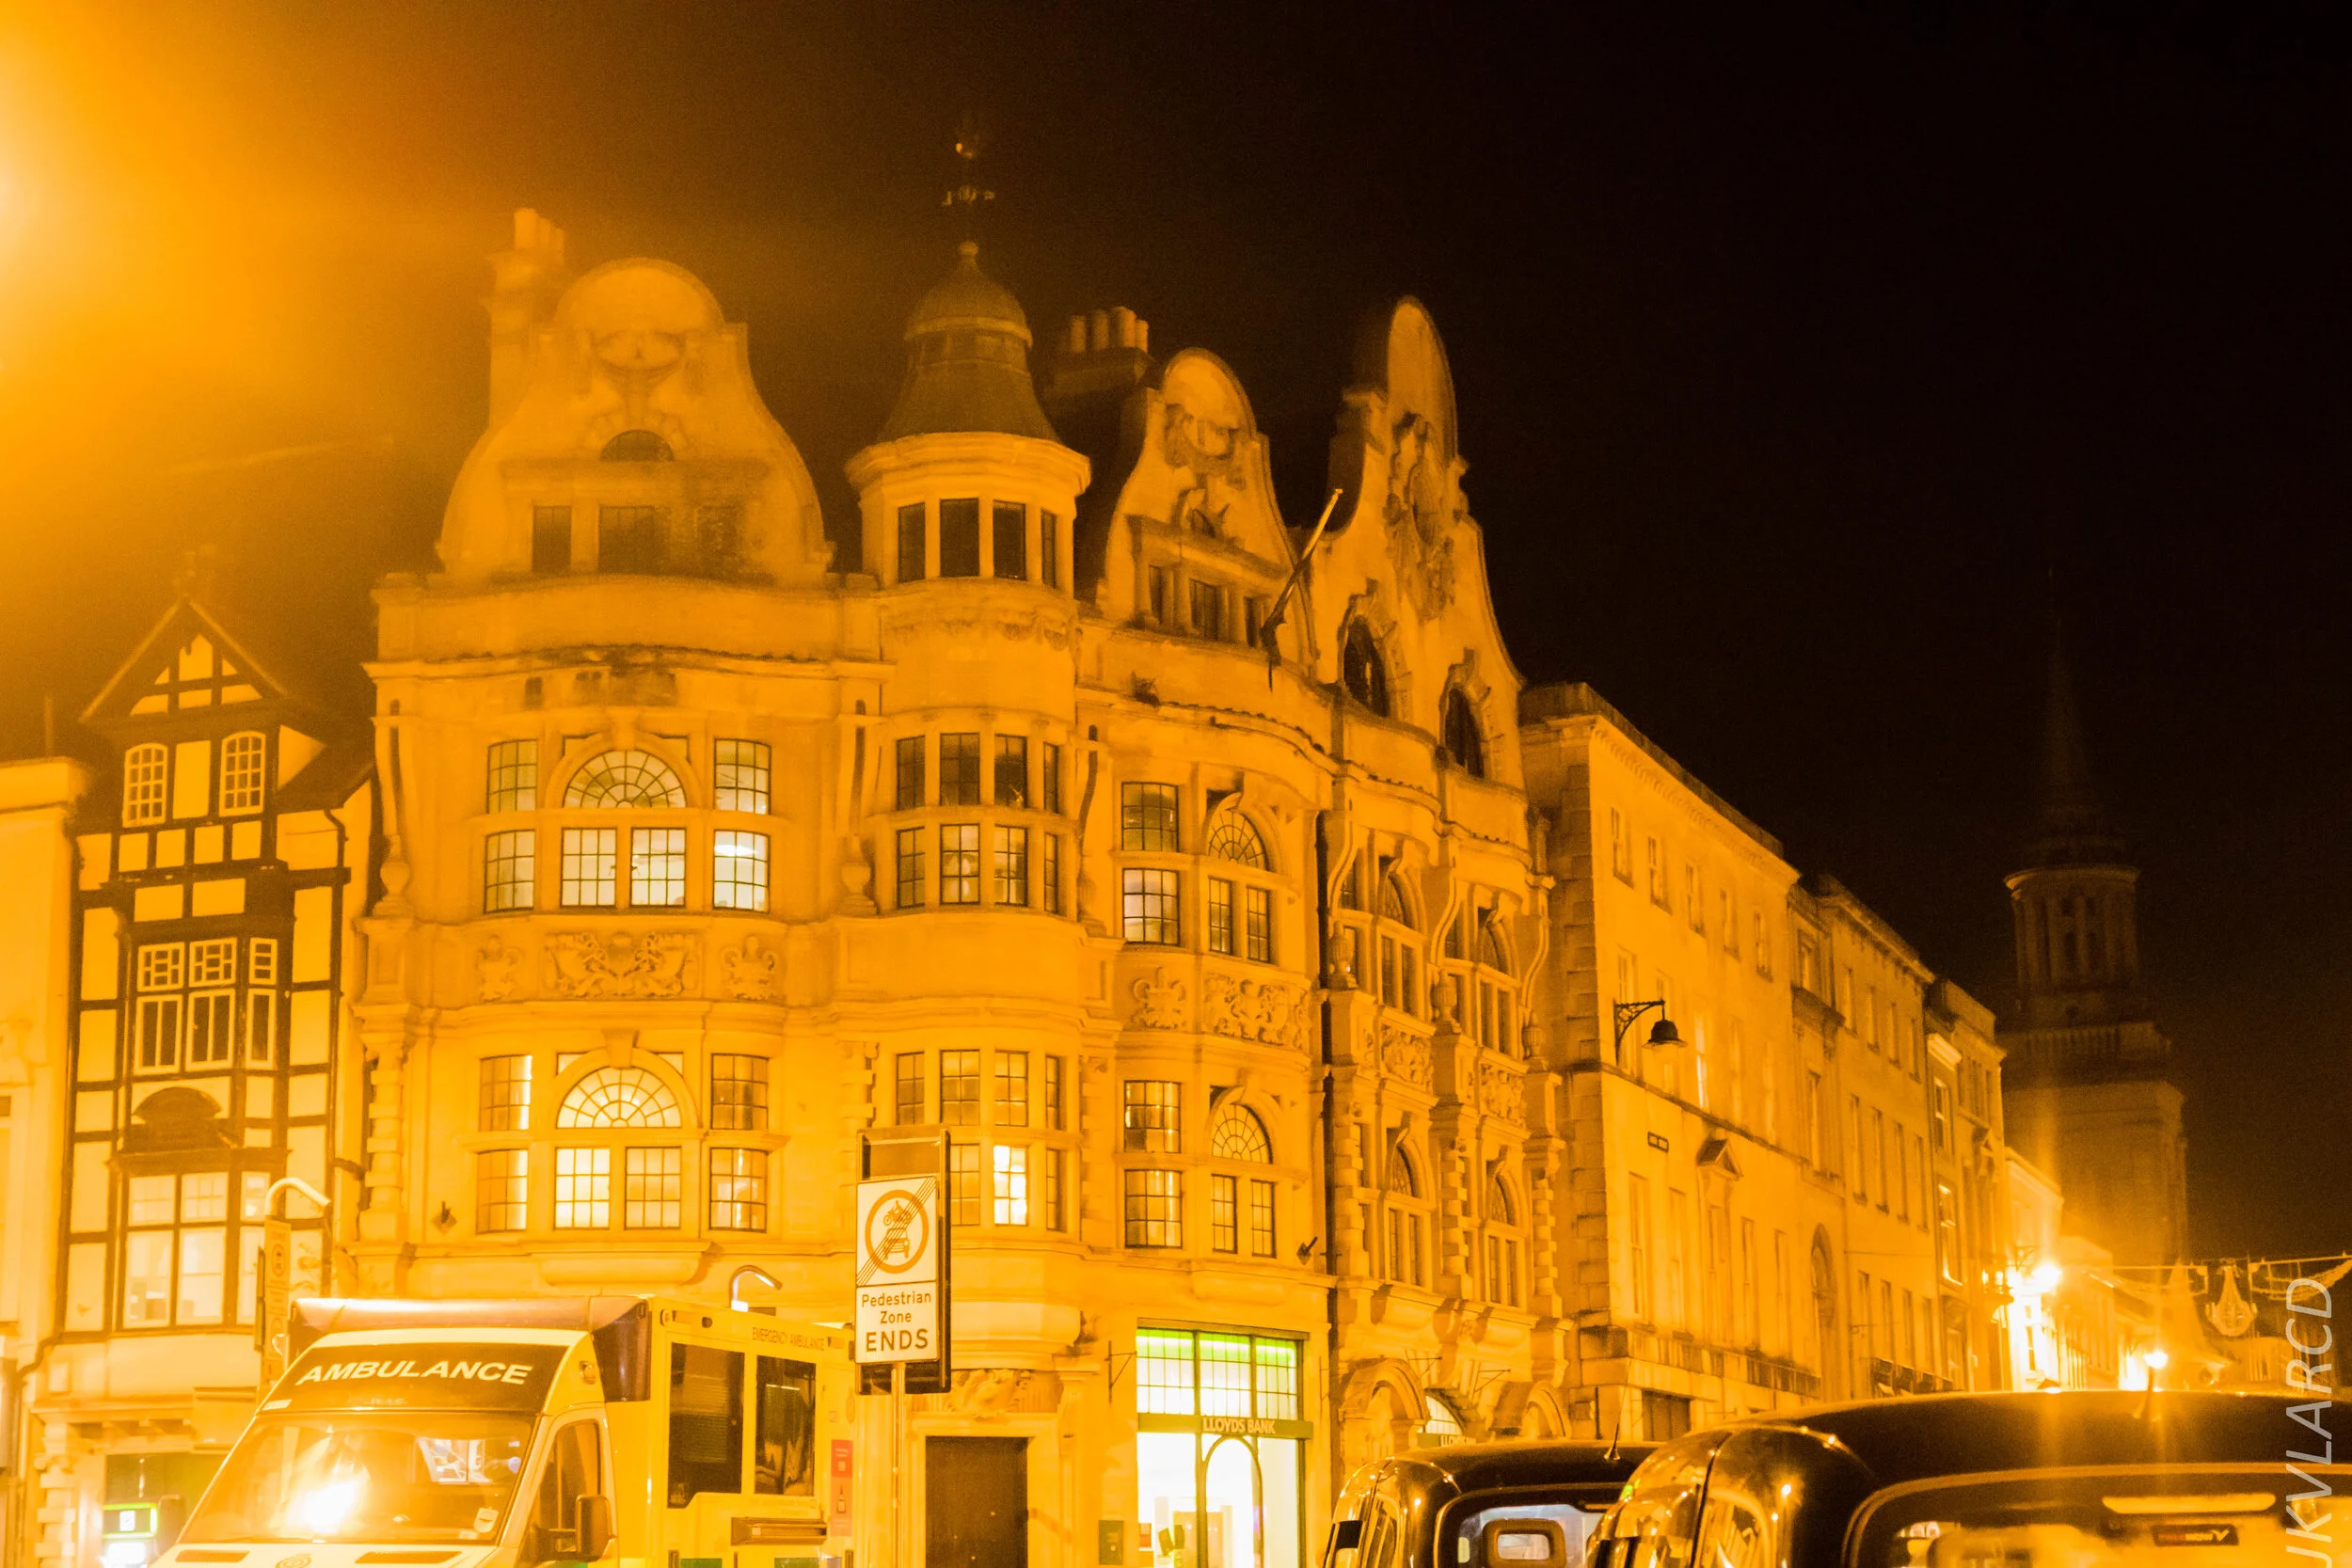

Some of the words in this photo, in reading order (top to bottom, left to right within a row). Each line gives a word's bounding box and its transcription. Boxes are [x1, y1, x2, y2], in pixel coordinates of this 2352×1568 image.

[861, 1291, 931, 1307] Pedestrian
[880, 1310, 912, 1324] Zone
[866, 1328, 929, 1353] ENDS
[294, 1360, 533, 1386] AMBULANCE
[1204, 1418, 1246, 1433] LLOYDS
[1248, 1419, 1276, 1434] BANK
